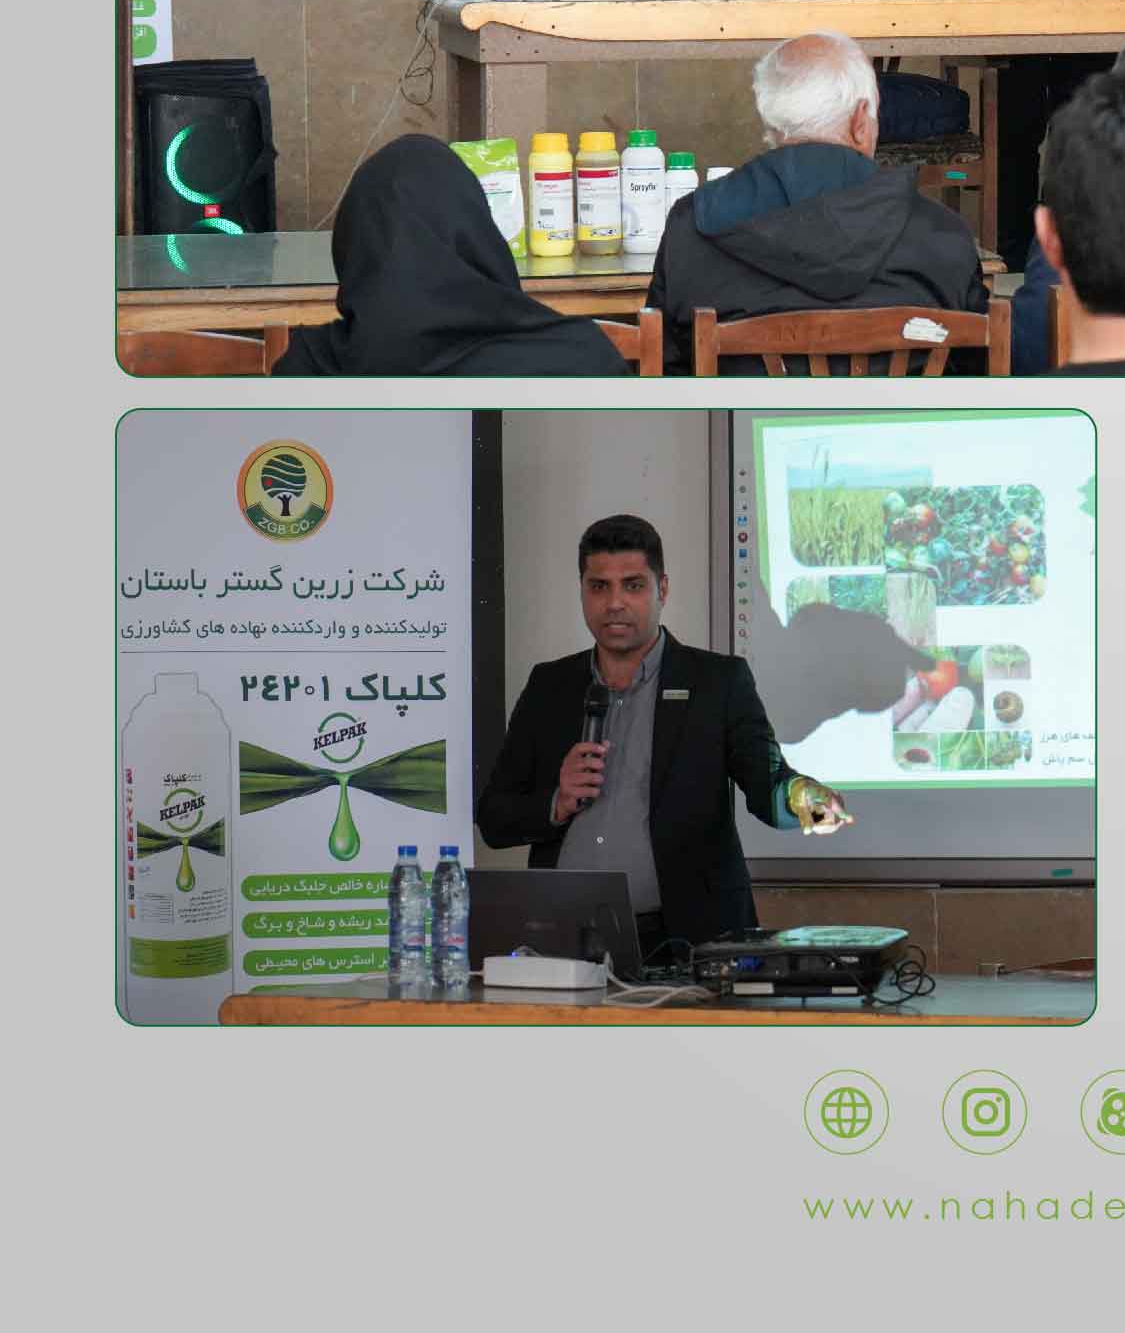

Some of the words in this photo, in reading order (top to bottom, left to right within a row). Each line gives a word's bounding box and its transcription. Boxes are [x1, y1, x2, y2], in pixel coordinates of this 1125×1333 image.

[257, 517, 286, 535] ZGB
[120, 567, 208, 599] باستان
[215, 564, 283, 599] گستر
[292, 569, 354, 600] زرین
[363, 568, 446, 600] شرکت
[120, 619, 192, 639] کشاورزی
[196, 620, 225, 639] های
[230, 620, 267, 639] نهاده
[271, 619, 347, 639] واردکننده
[351, 624, 360, 639] و
[364, 619, 448, 639] تولیدکننده
[345, 672, 448, 718] کلپاک
[313, 721, 368, 751] KELPAK
[160, 795, 206, 822] KELPAK
